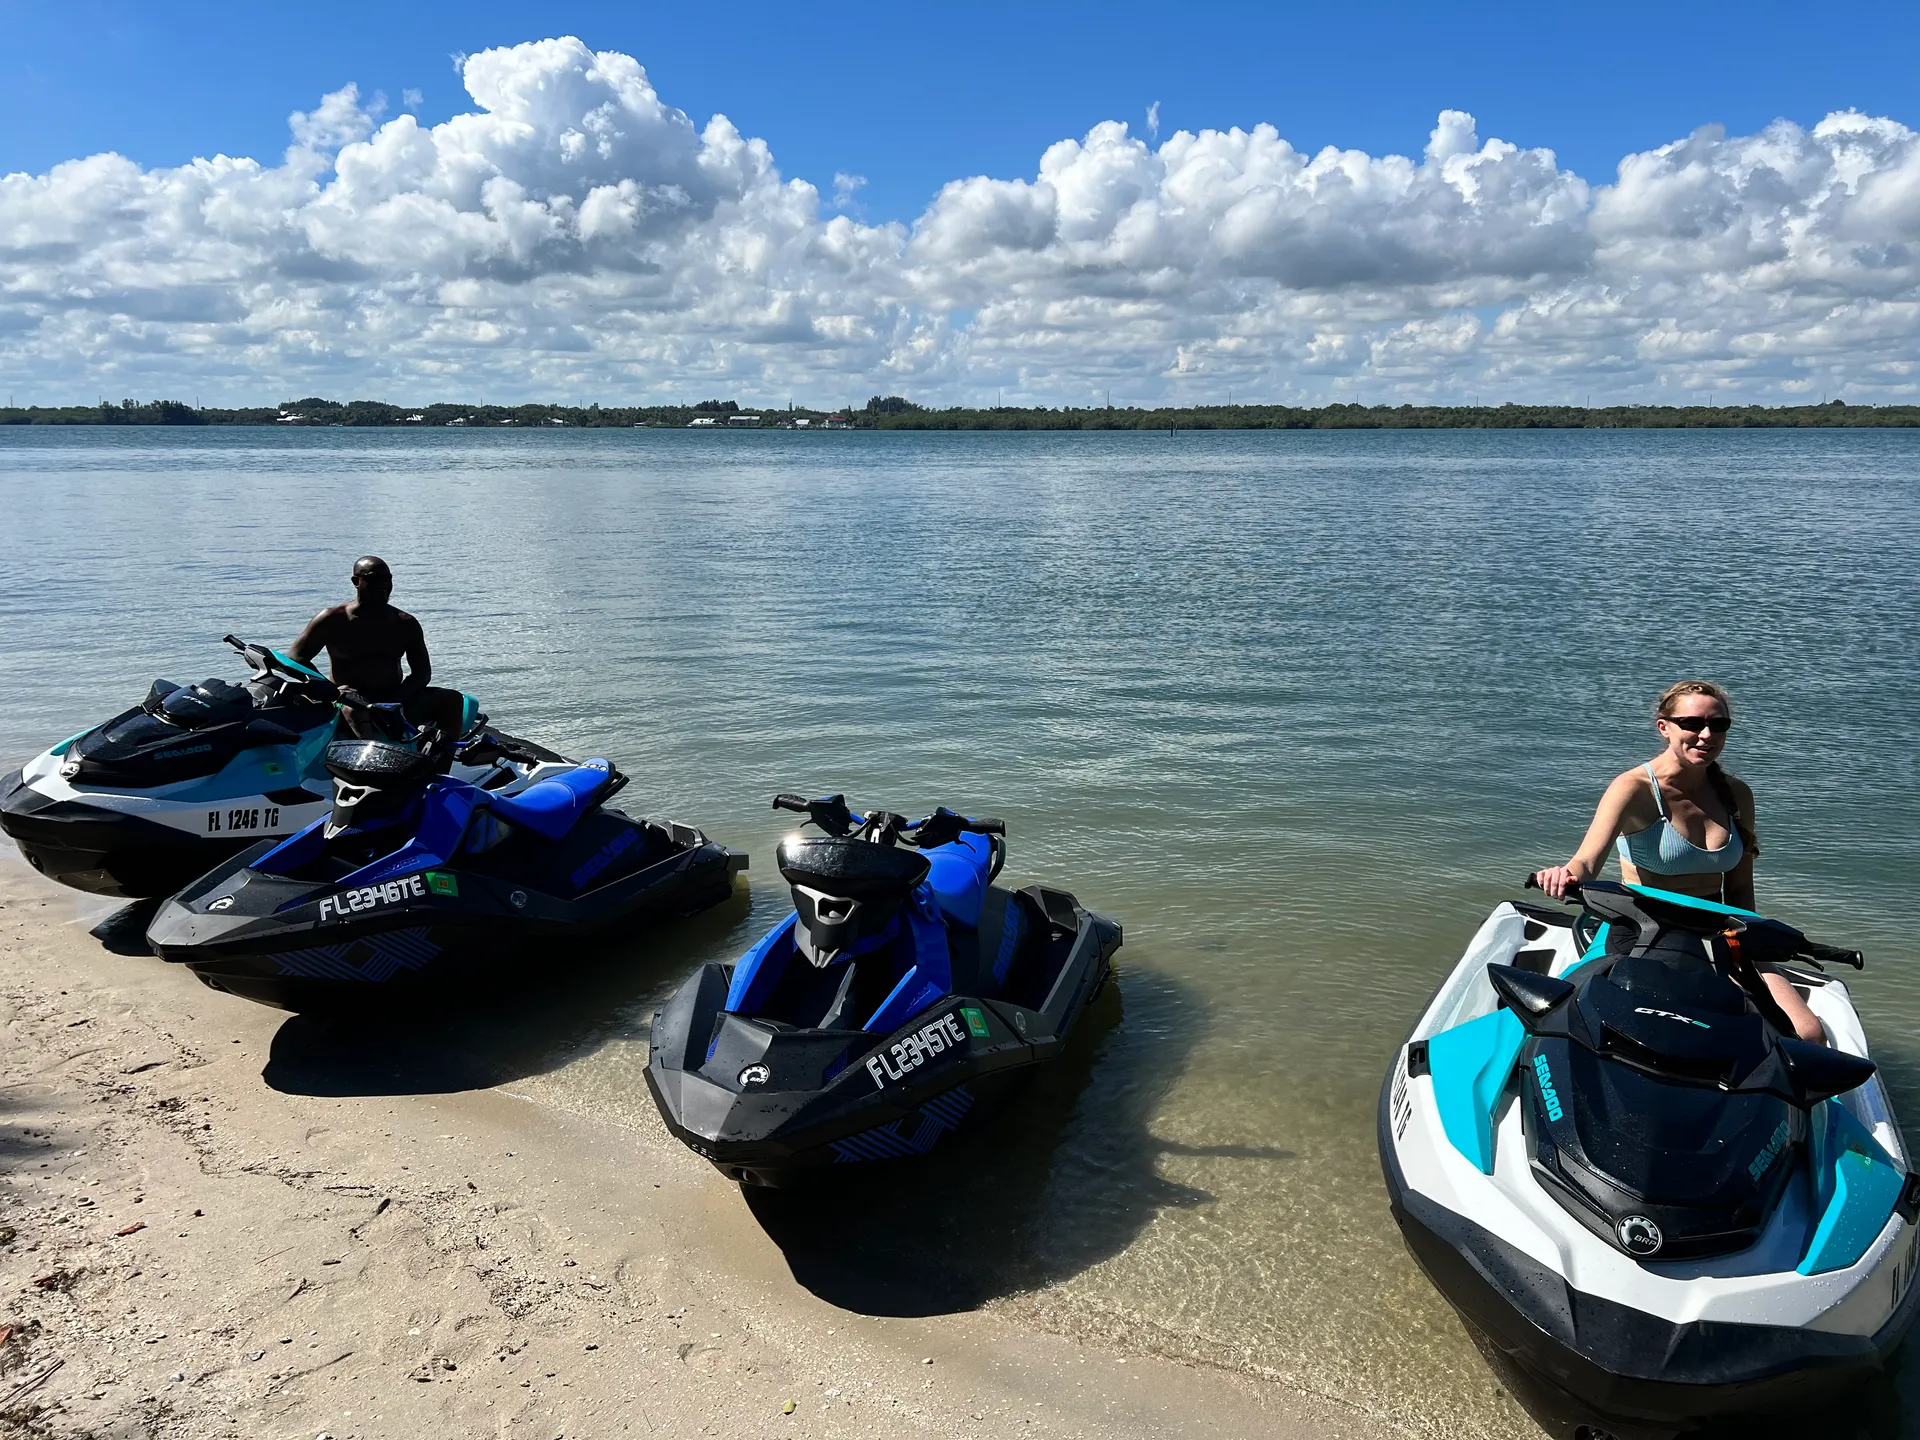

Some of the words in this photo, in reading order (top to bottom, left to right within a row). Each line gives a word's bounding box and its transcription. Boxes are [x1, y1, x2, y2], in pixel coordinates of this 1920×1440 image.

[208, 811, 221, 832] FL
[228, 809, 259, 830] 1246
[264, 808, 279, 828] TG
[319, 874, 426, 921] FL2346TE
[1634, 1007, 1693, 1024] GTX
[865, 1012, 966, 1090] FL2345TE
[1634, 1234, 1657, 1246] BRP
